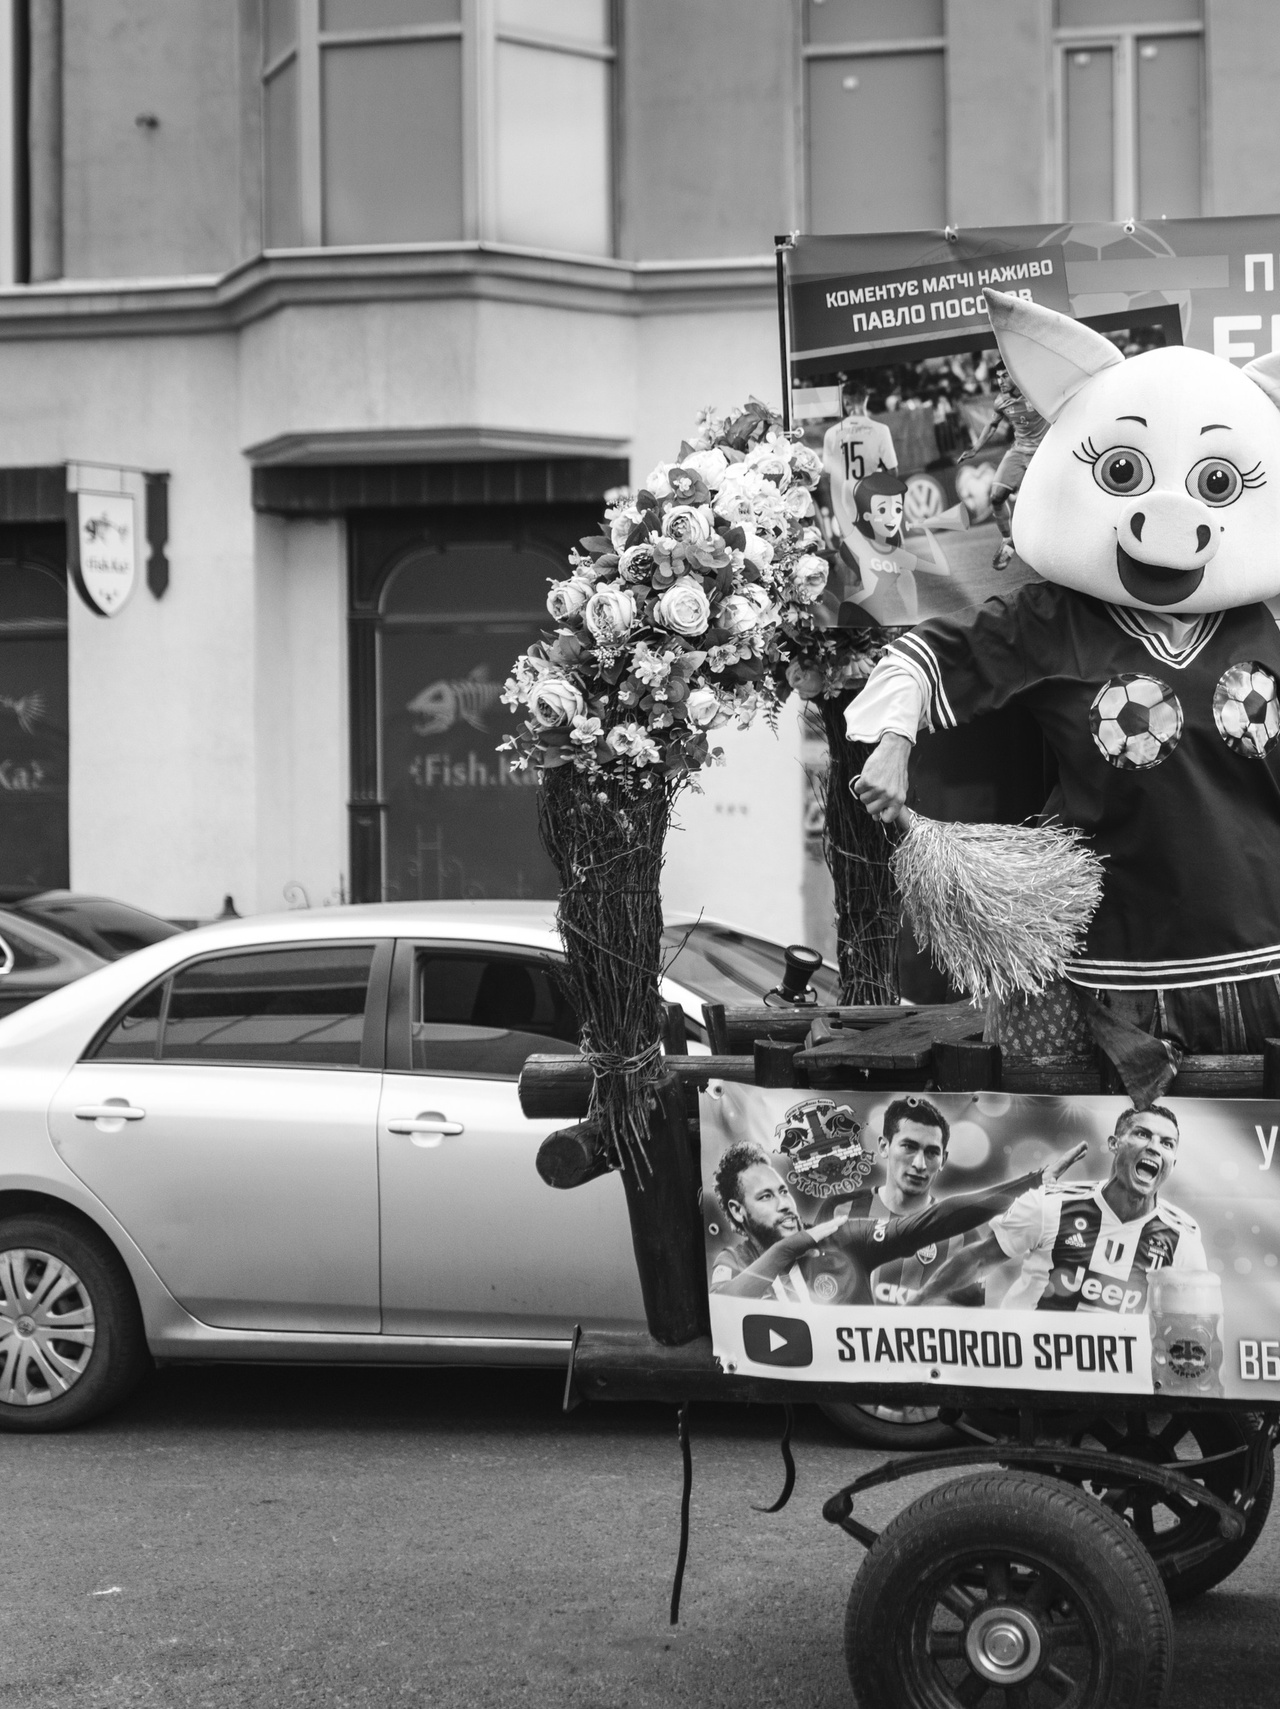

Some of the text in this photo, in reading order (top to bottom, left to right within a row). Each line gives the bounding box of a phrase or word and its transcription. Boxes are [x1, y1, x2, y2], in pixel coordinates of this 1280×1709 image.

[825, 279, 919, 309] КОМЕНТУЄ
[922, 271, 974, 294] МАТЧІ
[977, 258, 1054, 286] НАЖИВО
[852, 288, 1034, 333] ПАВЛО ПОСОВ
[841, 441, 866, 481] 15
[1254, 1125, 1279, 1171] У
[1060, 1265, 1142, 1314] Jeep
[836, 1326, 1138, 1374] STARGOROD SPORT
